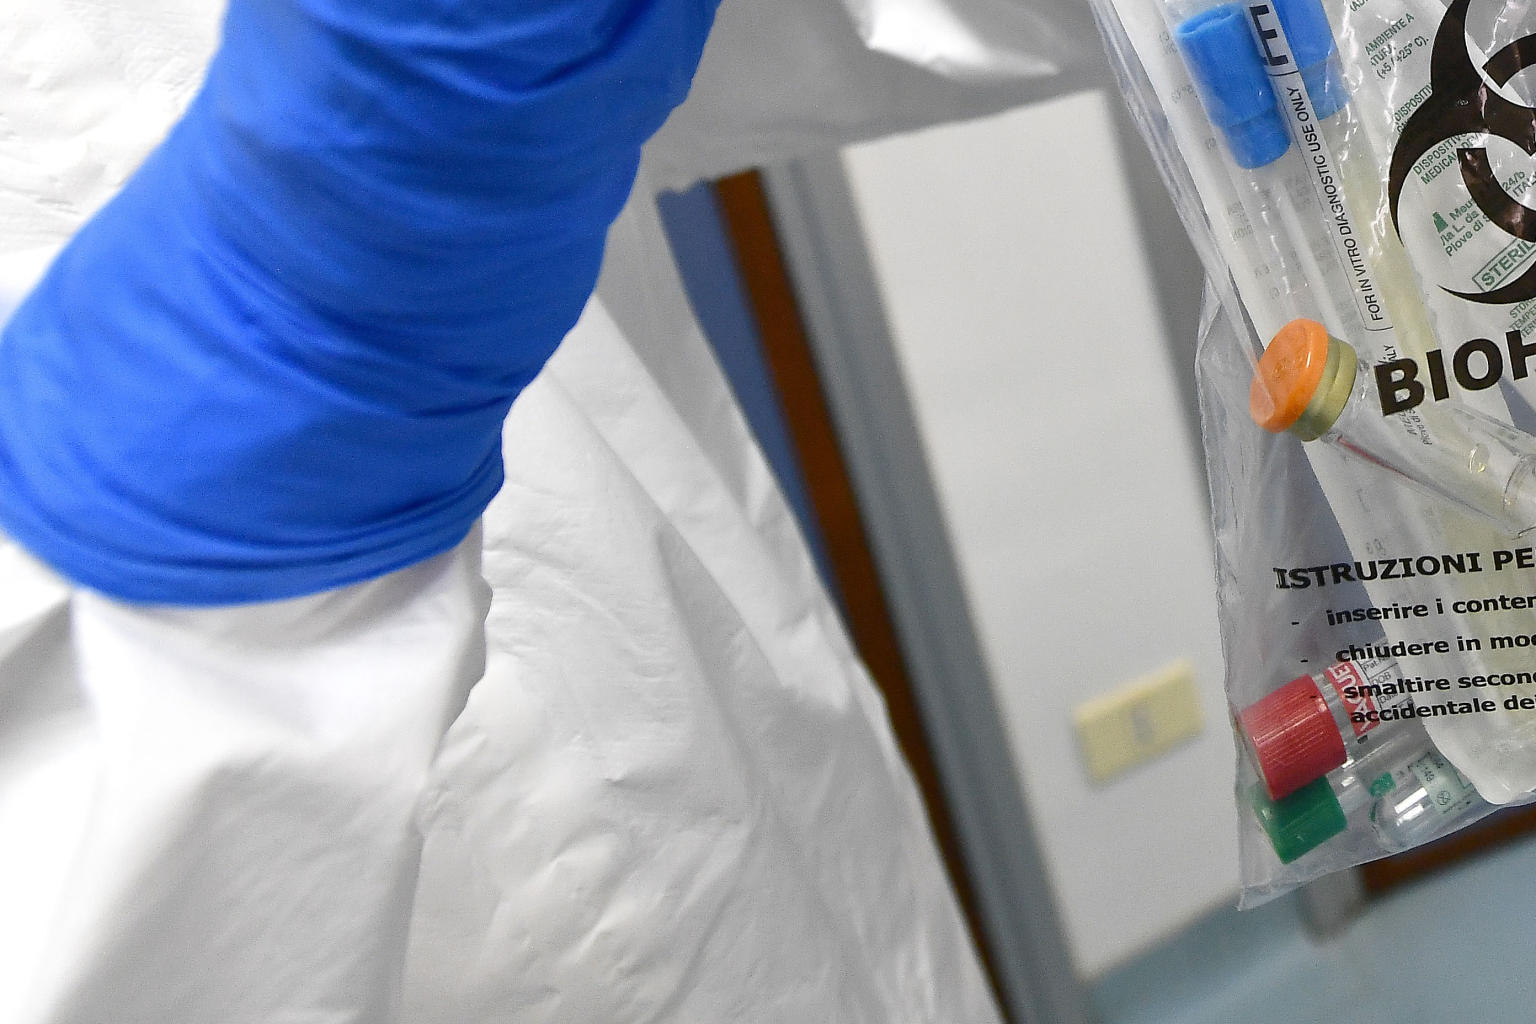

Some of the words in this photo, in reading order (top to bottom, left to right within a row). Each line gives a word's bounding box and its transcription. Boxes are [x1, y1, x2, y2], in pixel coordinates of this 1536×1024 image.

[1365, 16, 1408, 55] AMBIENTE
[1406, 12, 1415, 24] A
[1286, 87, 1310, 122] ONLY
[1302, 124, 1320, 152] USE
[1313, 154, 1351, 236] DIAGNOSTIC
[1465, 210, 1480, 224] da
[1445, 231, 1473, 256] Piove
[1473, 219, 1484, 232] di
[1343, 238, 1366, 276] VITRO
[1357, 278, 1373, 292] IN
[1364, 294, 1384, 321] FOR
[1273, 552, 1482, 590] ISTRUZIONI
[1326, 602, 1429, 626] inserire
[1435, 598, 1444, 615] i
[1336, 638, 1450, 663] chiudere
[1457, 635, 1482, 651] in
[1343, 676, 1450, 699] smaltire
[1350, 698, 1496, 724] accidentale
